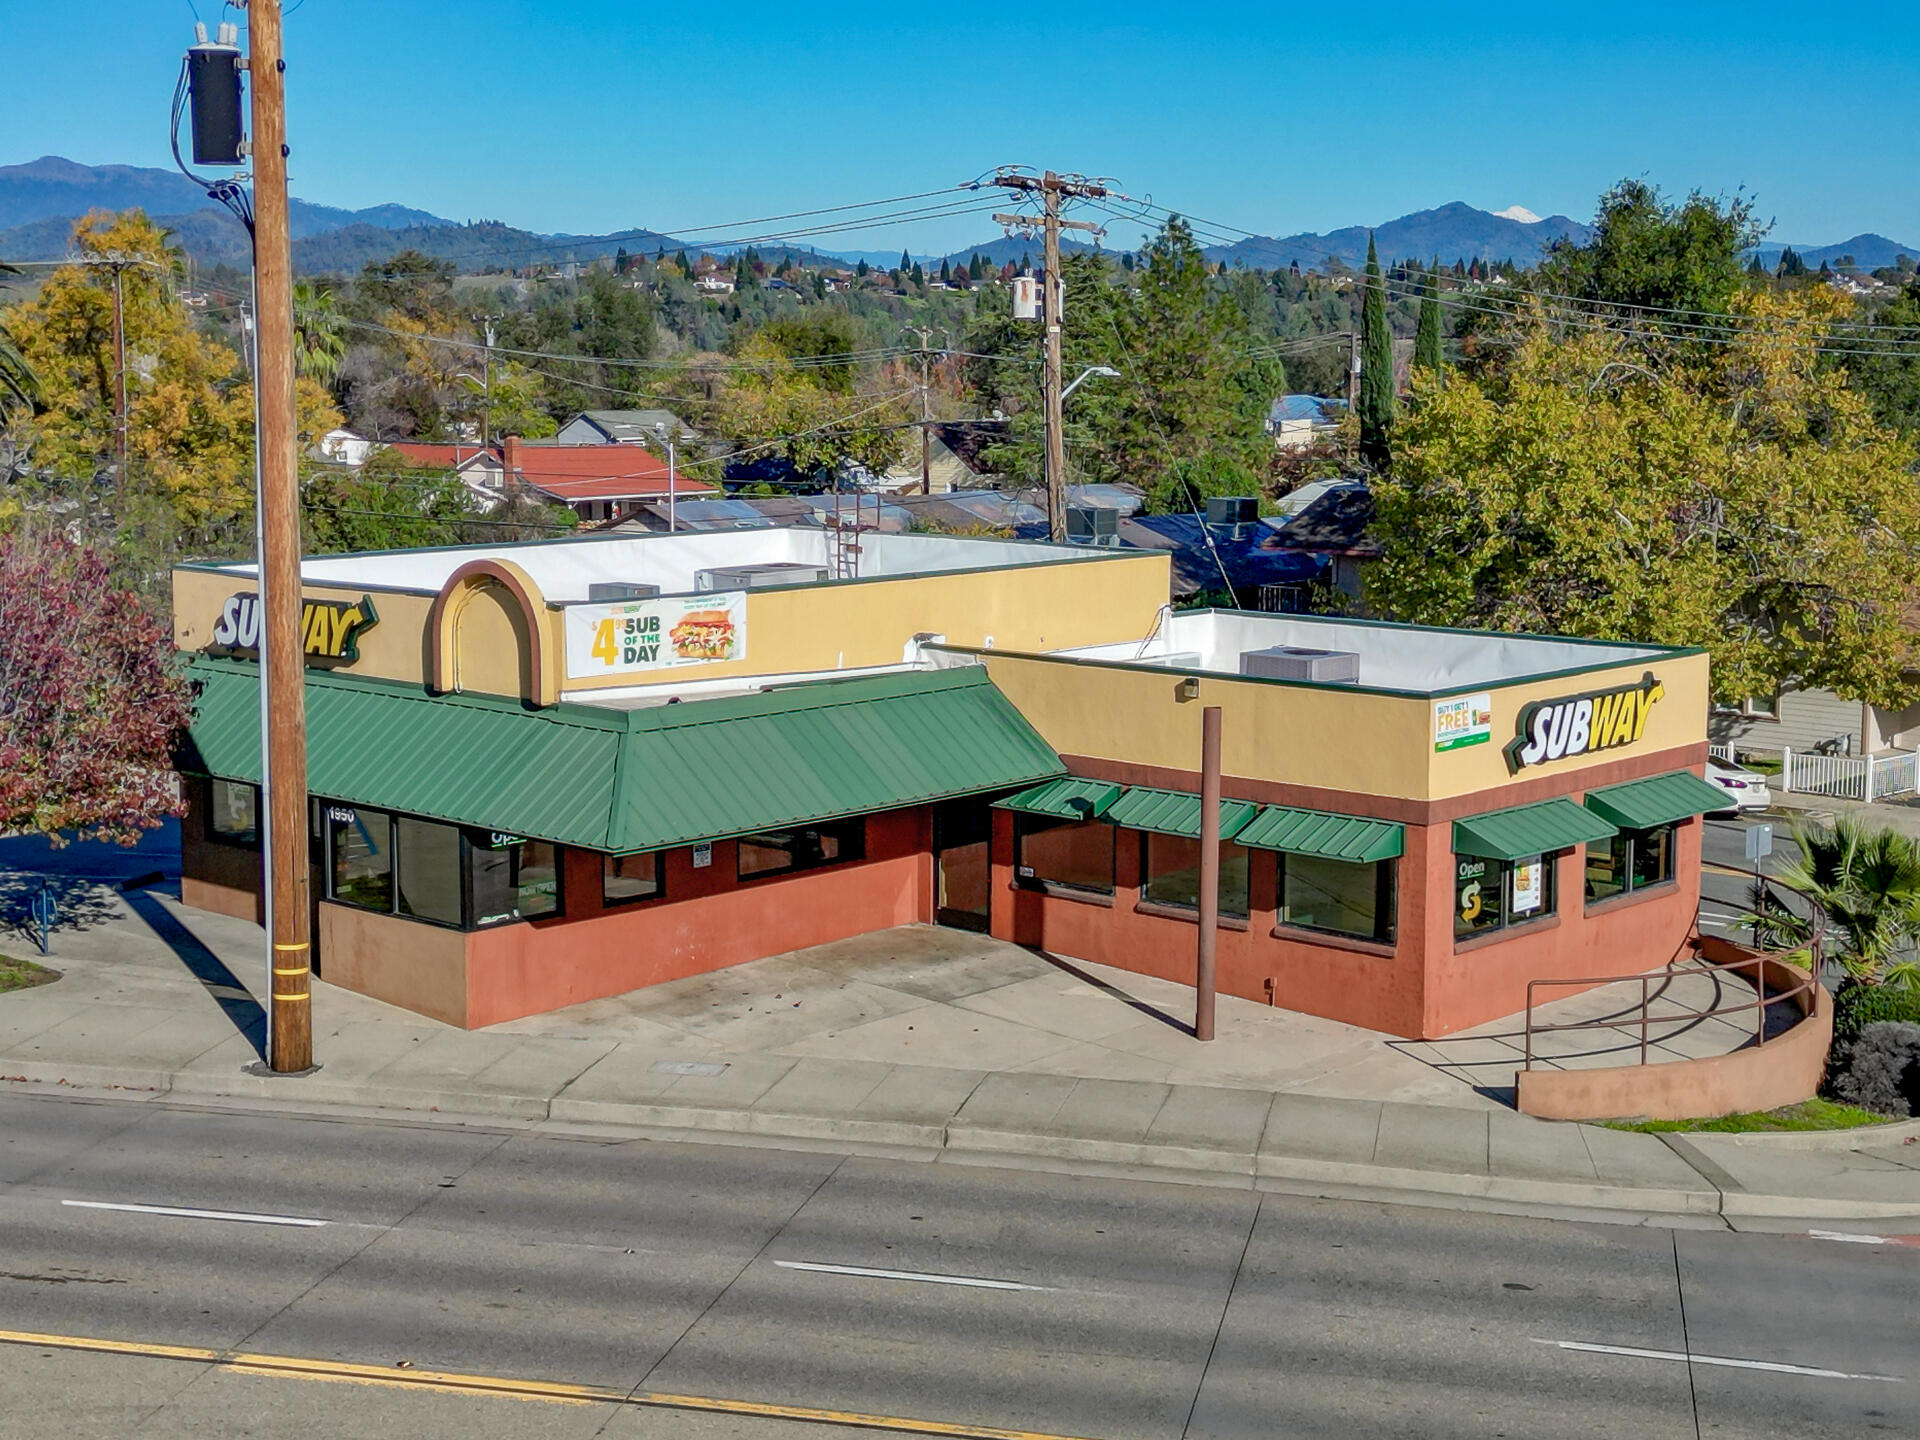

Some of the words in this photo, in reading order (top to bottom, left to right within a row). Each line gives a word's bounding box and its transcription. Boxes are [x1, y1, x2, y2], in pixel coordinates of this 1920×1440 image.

[214, 597, 364, 657] SUAY
[624, 616, 660, 635] SUB
[624, 636, 638, 645] OF
[640, 634, 660, 644] THE
[624, 645, 660, 664] DAY
[1438, 709, 1469, 731] FREE
[1521, 680, 1665, 765] SUBWAY
[1459, 862, 1485, 878] Open
